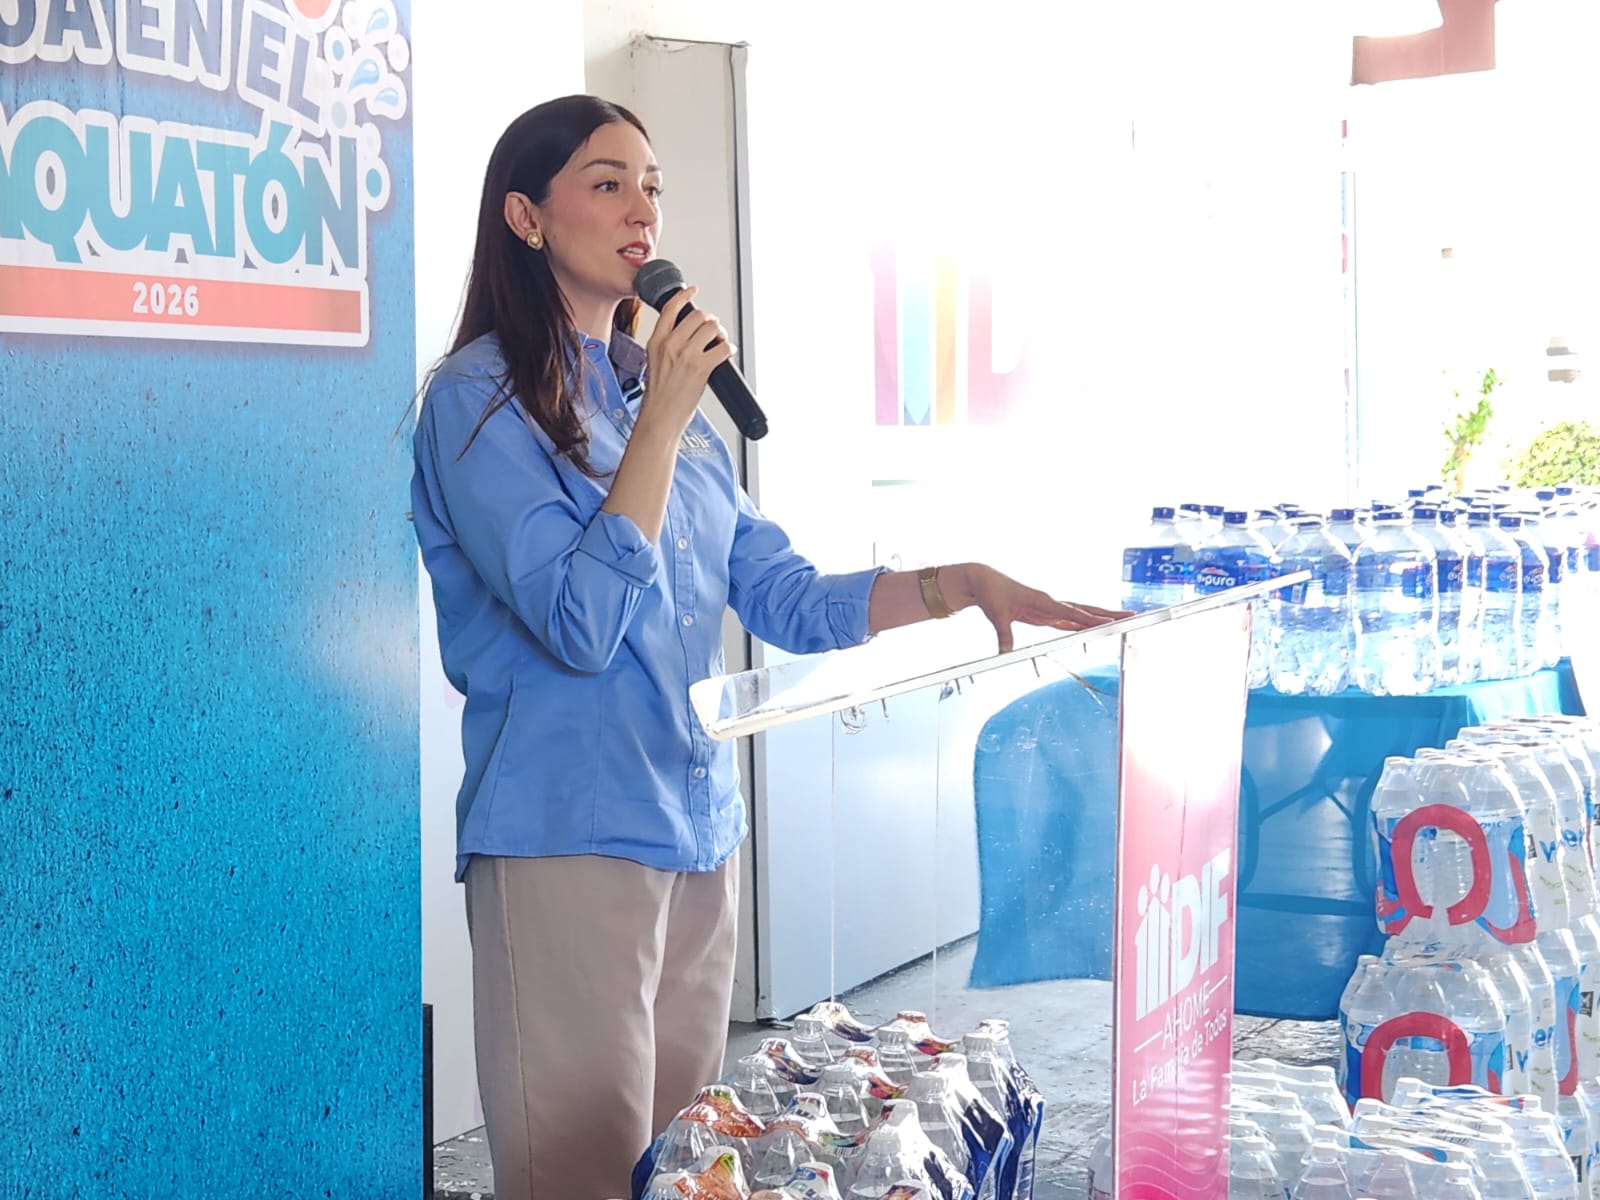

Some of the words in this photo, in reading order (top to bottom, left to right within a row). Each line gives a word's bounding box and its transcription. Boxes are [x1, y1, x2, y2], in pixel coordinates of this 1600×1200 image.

[246, 14, 322, 125] EL
[132, 282, 200, 317] 2026
[1172, 848, 1231, 998] DIF
[1133, 1079, 1147, 1106] La
[1192, 1030, 1203, 1058] de
[1204, 1008, 1227, 1046] Todos
[1162, 979, 1210, 1050] AHOME
